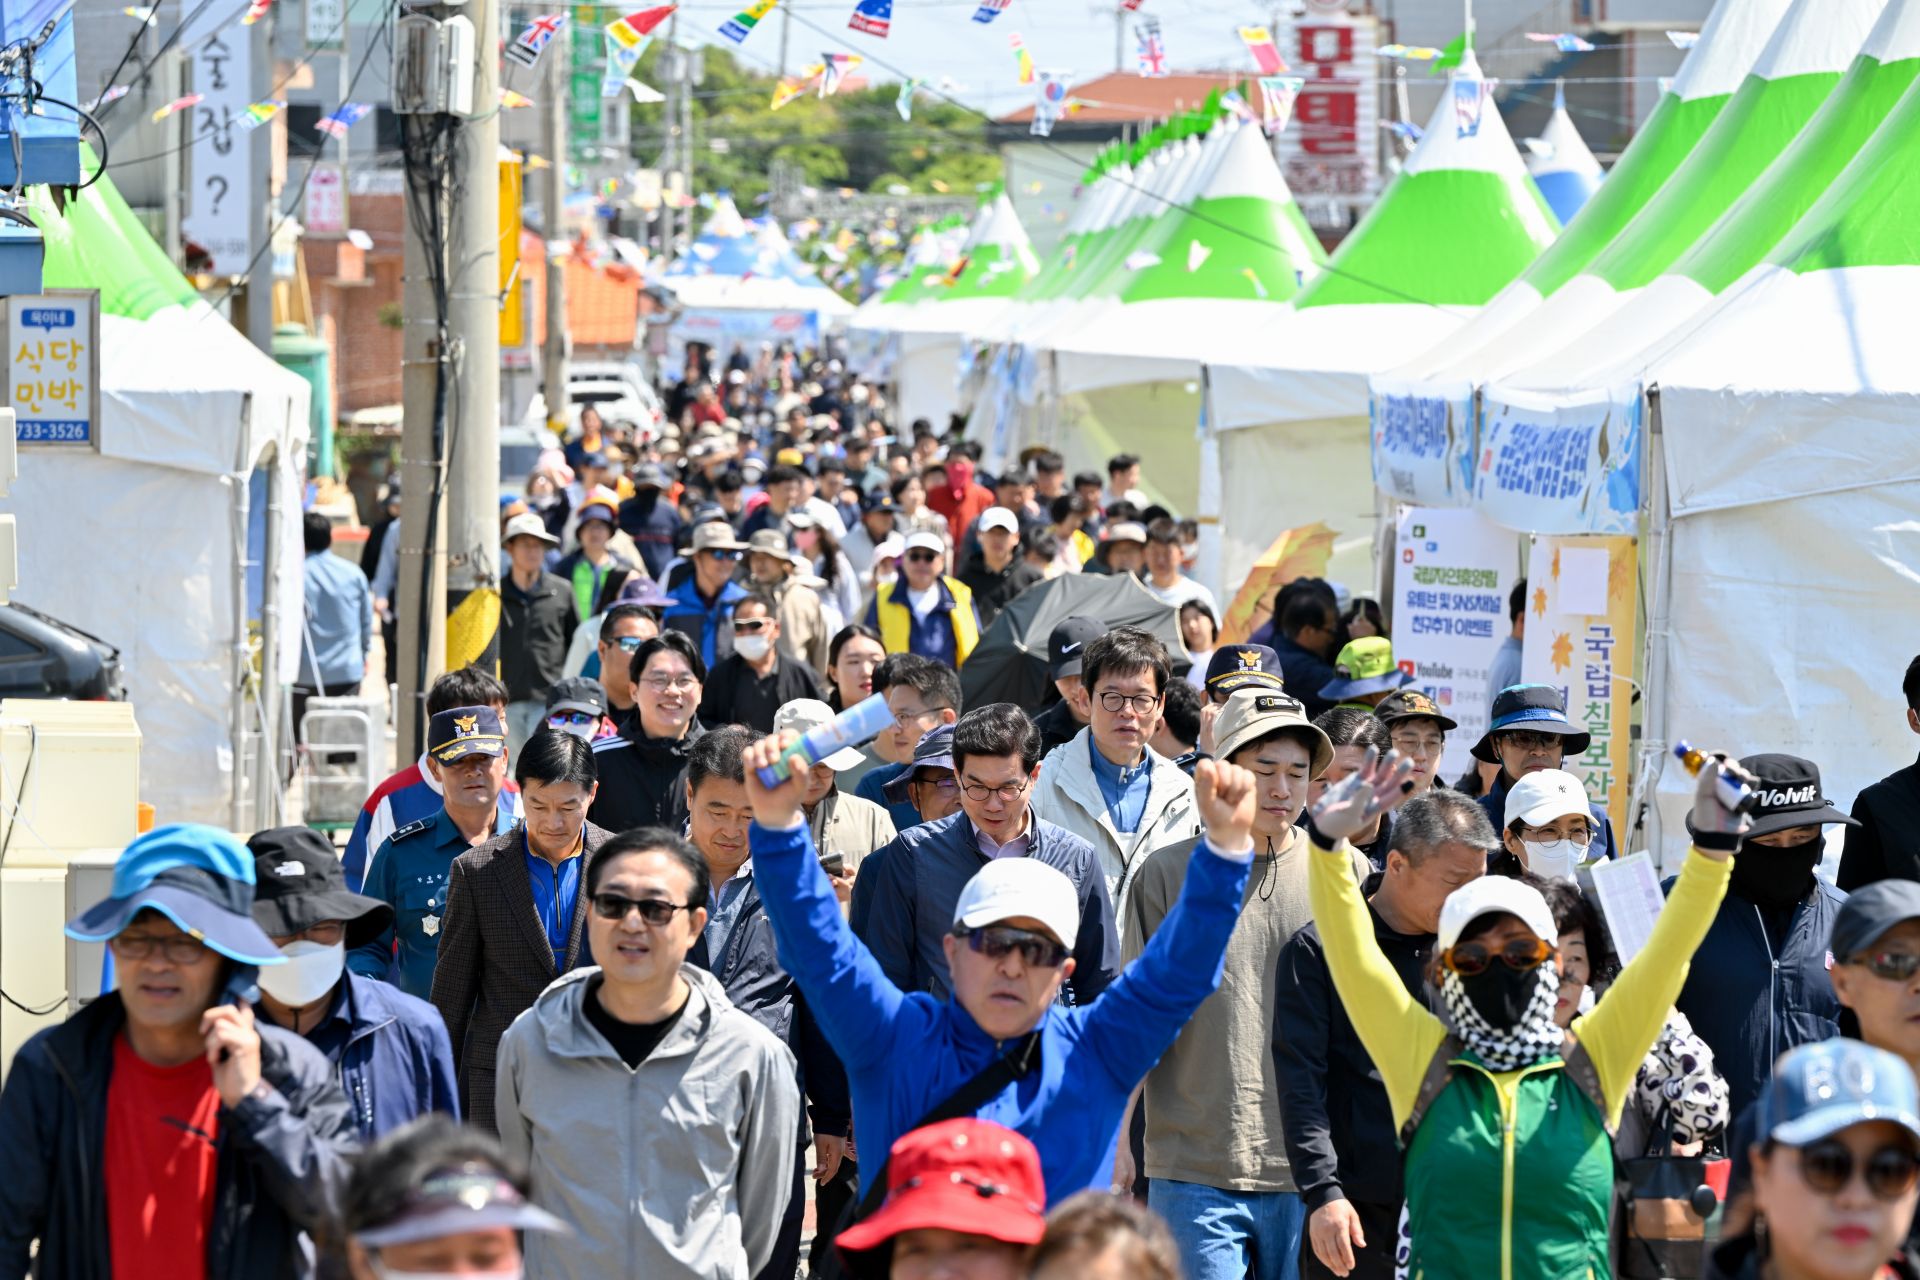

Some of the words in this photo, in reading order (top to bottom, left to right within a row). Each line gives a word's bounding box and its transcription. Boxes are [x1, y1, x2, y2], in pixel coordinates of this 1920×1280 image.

[15, 338, 84, 374] 식당
[15, 377, 84, 414] 민박
[16, 423, 84, 440] 733-3526
[1407, 590, 1437, 610] 유튜브
[1440, 591, 1451, 610] 및
[1412, 614, 1452, 635] 친구추가
[1454, 618, 1493, 638] 이벤트
[1416, 662, 1453, 679] YouTube
[1757, 785, 1817, 807] Volvik
